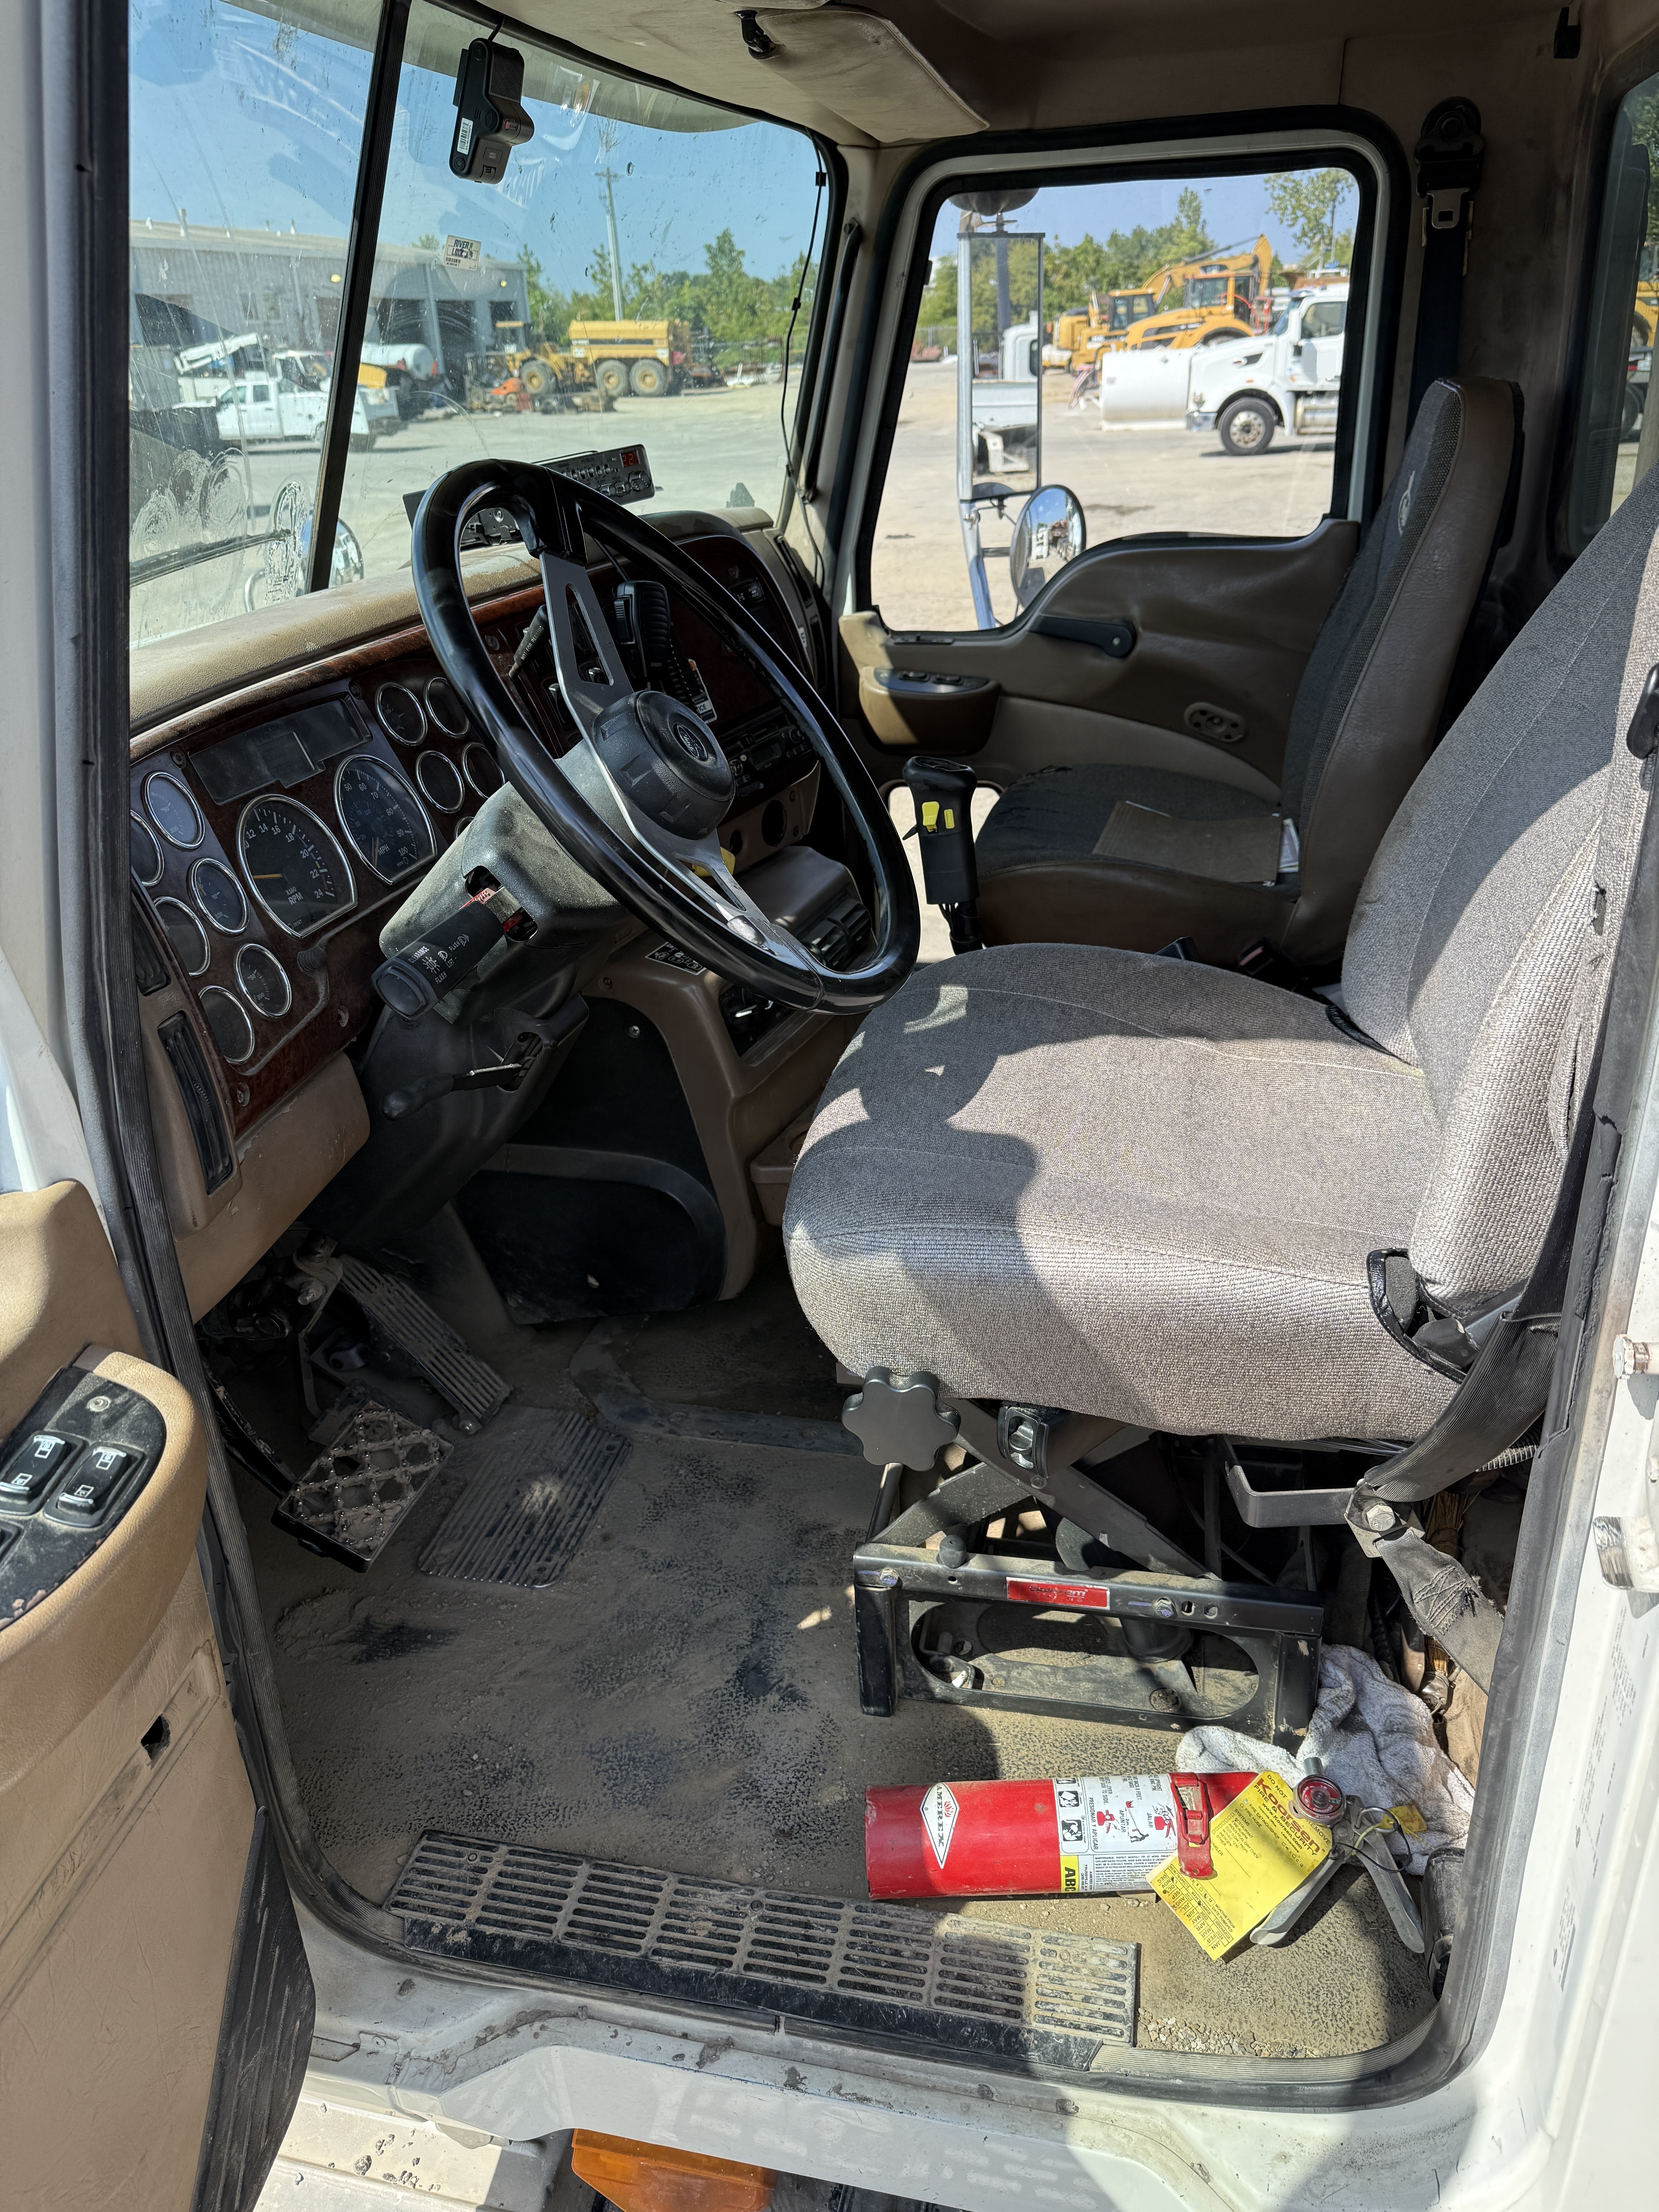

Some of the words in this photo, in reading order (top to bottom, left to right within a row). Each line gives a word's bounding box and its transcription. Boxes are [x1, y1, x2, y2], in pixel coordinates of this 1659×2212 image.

[454, 239, 469, 249] RIVER
[520, 651, 528, 661] NOT
[343, 782, 352, 792] 50
[358, 782, 367, 792] 60
[370, 790, 379, 800] 70
[385, 807, 394, 816] 80
[258, 822, 269, 833] 14
[270, 824, 282, 835] 16
[396, 828, 405, 838] 90
[245, 828, 256, 839] 12
[284, 832, 295, 843] 18
[299, 848, 310, 859] 20
[376, 843, 390, 856] MPH
[397, 845, 409, 857] 100
[309, 868, 319, 879] 22
[287, 891, 304, 905] RPM
[313, 888, 324, 898] 24
[448, 940, 461, 952] FLASH
[406, 944, 431, 965] CLEARANCE
[433, 971, 448, 984] FLASH
[1266, 1774, 1276, 1784] DO
[1274, 1785, 1287, 1799] NOT
[1234, 1808, 1250, 1827] SYSTEMS
[1244, 1808, 1253, 1817] FIRE
[1251, 1816, 1262, 1828] HOSE
[1253, 1784, 1270, 1803] FIRE
[1271, 1805, 1279, 1813] &
[1279, 1814, 1317, 1858] SECURITY
[1255, 1777, 1322, 1854] Koorsen
[1249, 1803, 1257, 1813] FIRE
[1256, 1812, 1280, 1840] EXTINGUISHER
[1262, 1802, 1303, 1850] www.Koorsen.com
[1216, 1834, 1226, 1846] OTHER
[1211, 1842, 1223, 1856] INKLER
[1064, 1866, 1076, 1891] ABC
[1157, 1874, 1167, 1884] DEC
[1161, 1879, 1171, 1889] NOV
[1170, 1890, 1180, 1899] SEP
[1175, 1896, 1186, 1907] AUG
[1181, 1902, 1191, 1911] JUL
[1190, 1891, 1211, 1915] MAINANCE
[1186, 1908, 1196, 1918] JUN
[1214, 1903, 1228, 1919] MONTHS
[1226, 1918, 1236, 1929] FROM
[1190, 1914, 1201, 1925] MAY
[1211, 1906, 1220, 1916] DATE
[1218, 1915, 1233, 1932] PUNCHED
[1195, 1921, 1206, 1931] APR
[1214, 1920, 1231, 1940] RECHARGE
[1200, 1927, 1212, 1938] MAR
[1206, 1934, 1216, 1943] FEB
[1211, 1941, 1221, 1951] JAN
